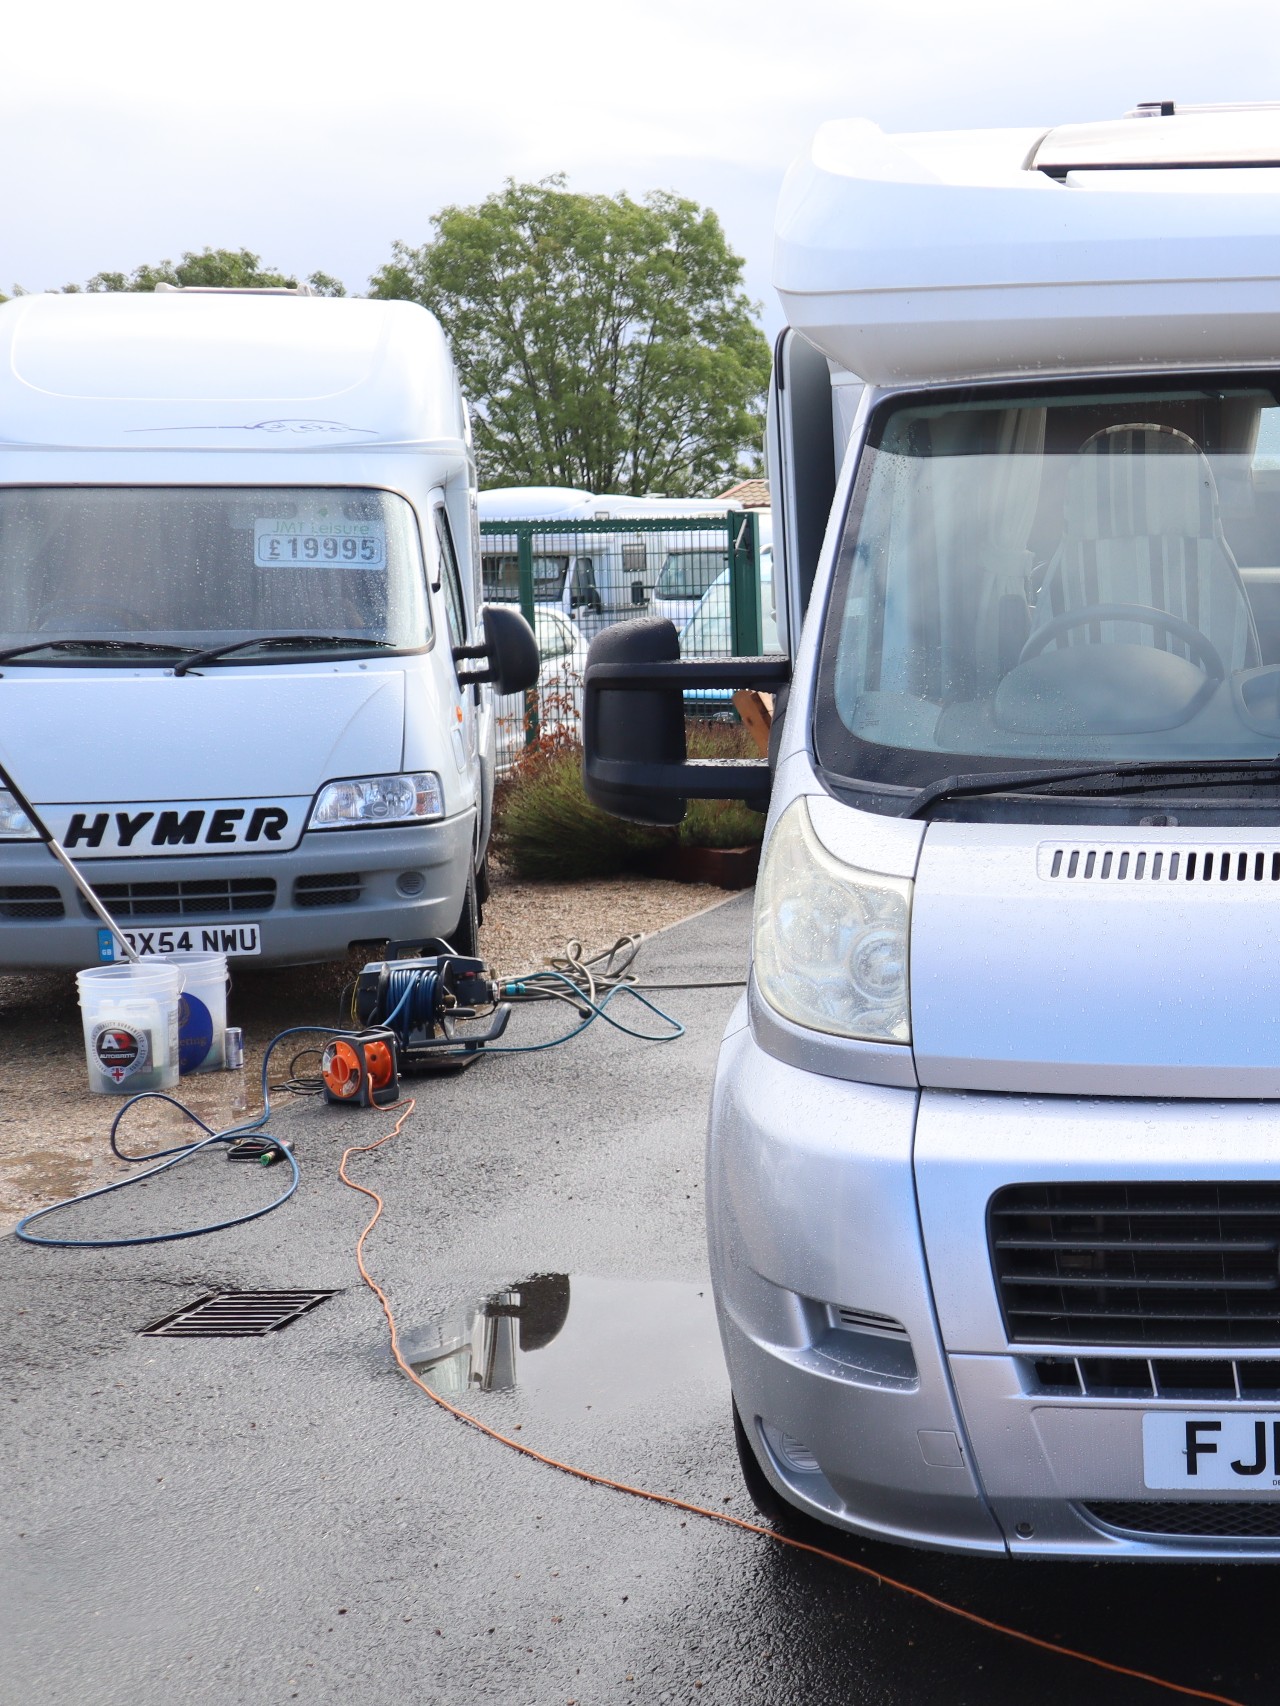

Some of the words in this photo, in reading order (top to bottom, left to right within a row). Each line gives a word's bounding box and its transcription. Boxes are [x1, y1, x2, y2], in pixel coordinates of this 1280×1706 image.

[272, 521, 304, 534] JMT
[311, 521, 370, 535] Leisure
[268, 537, 375, 560] £19995
[62, 807, 289, 848] HYMER
[201, 928, 257, 952] NWU
